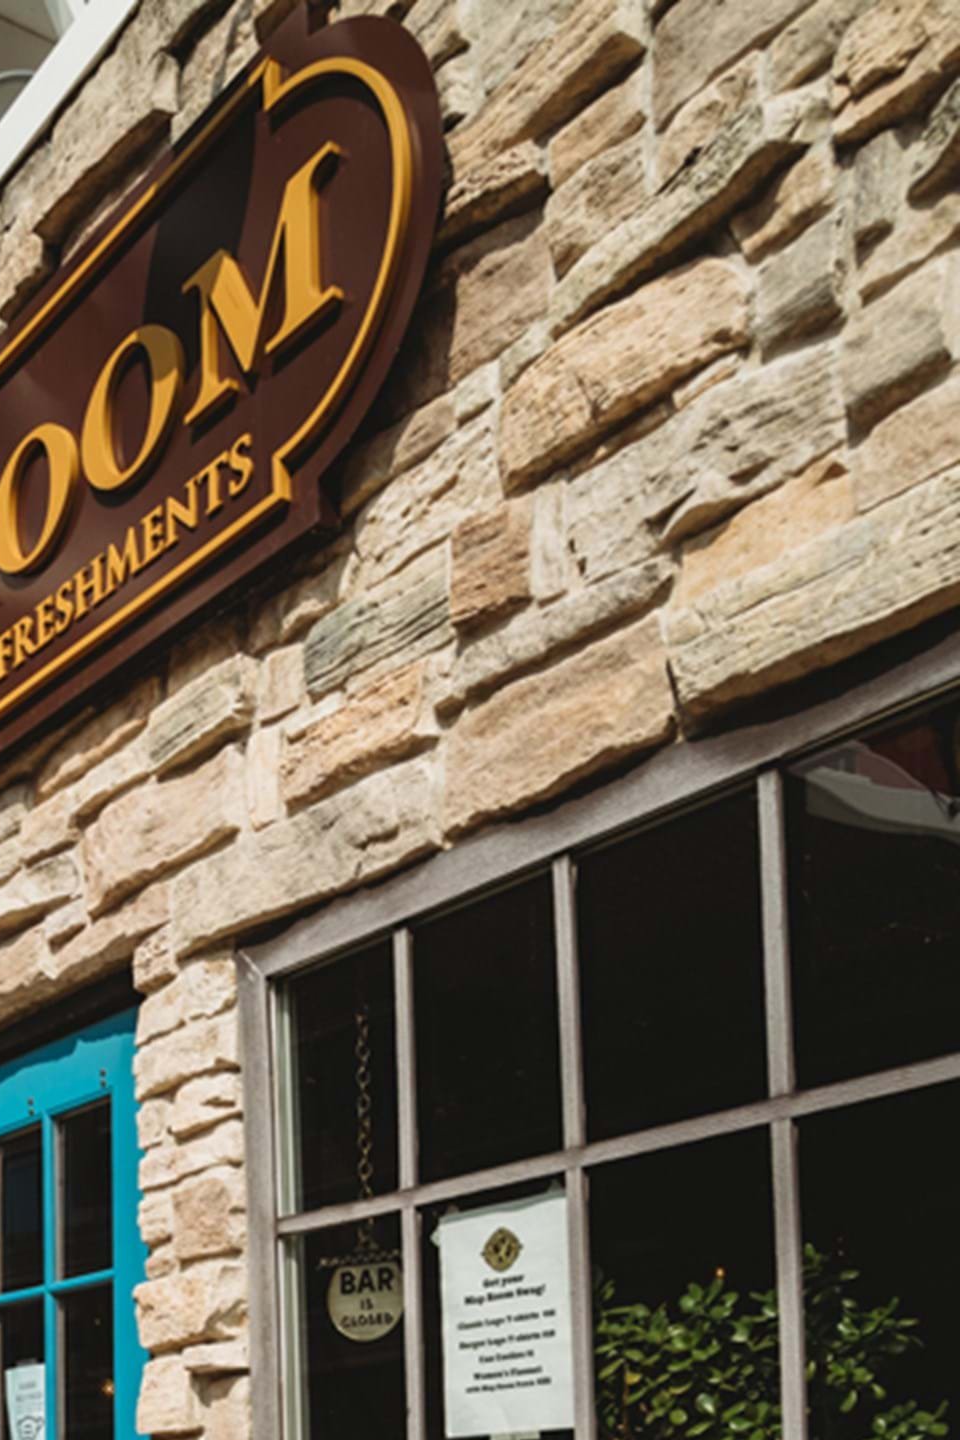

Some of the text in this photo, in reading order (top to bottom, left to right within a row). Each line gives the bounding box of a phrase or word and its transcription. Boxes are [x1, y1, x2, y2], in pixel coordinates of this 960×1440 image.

[340, 1266, 393, 1295] BAR
[359, 1297, 374, 1311] IS
[464, 1295, 485, 1307] Map
[487, 1291, 514, 1302] Room
[340, 1311, 394, 1329] CLOSED
